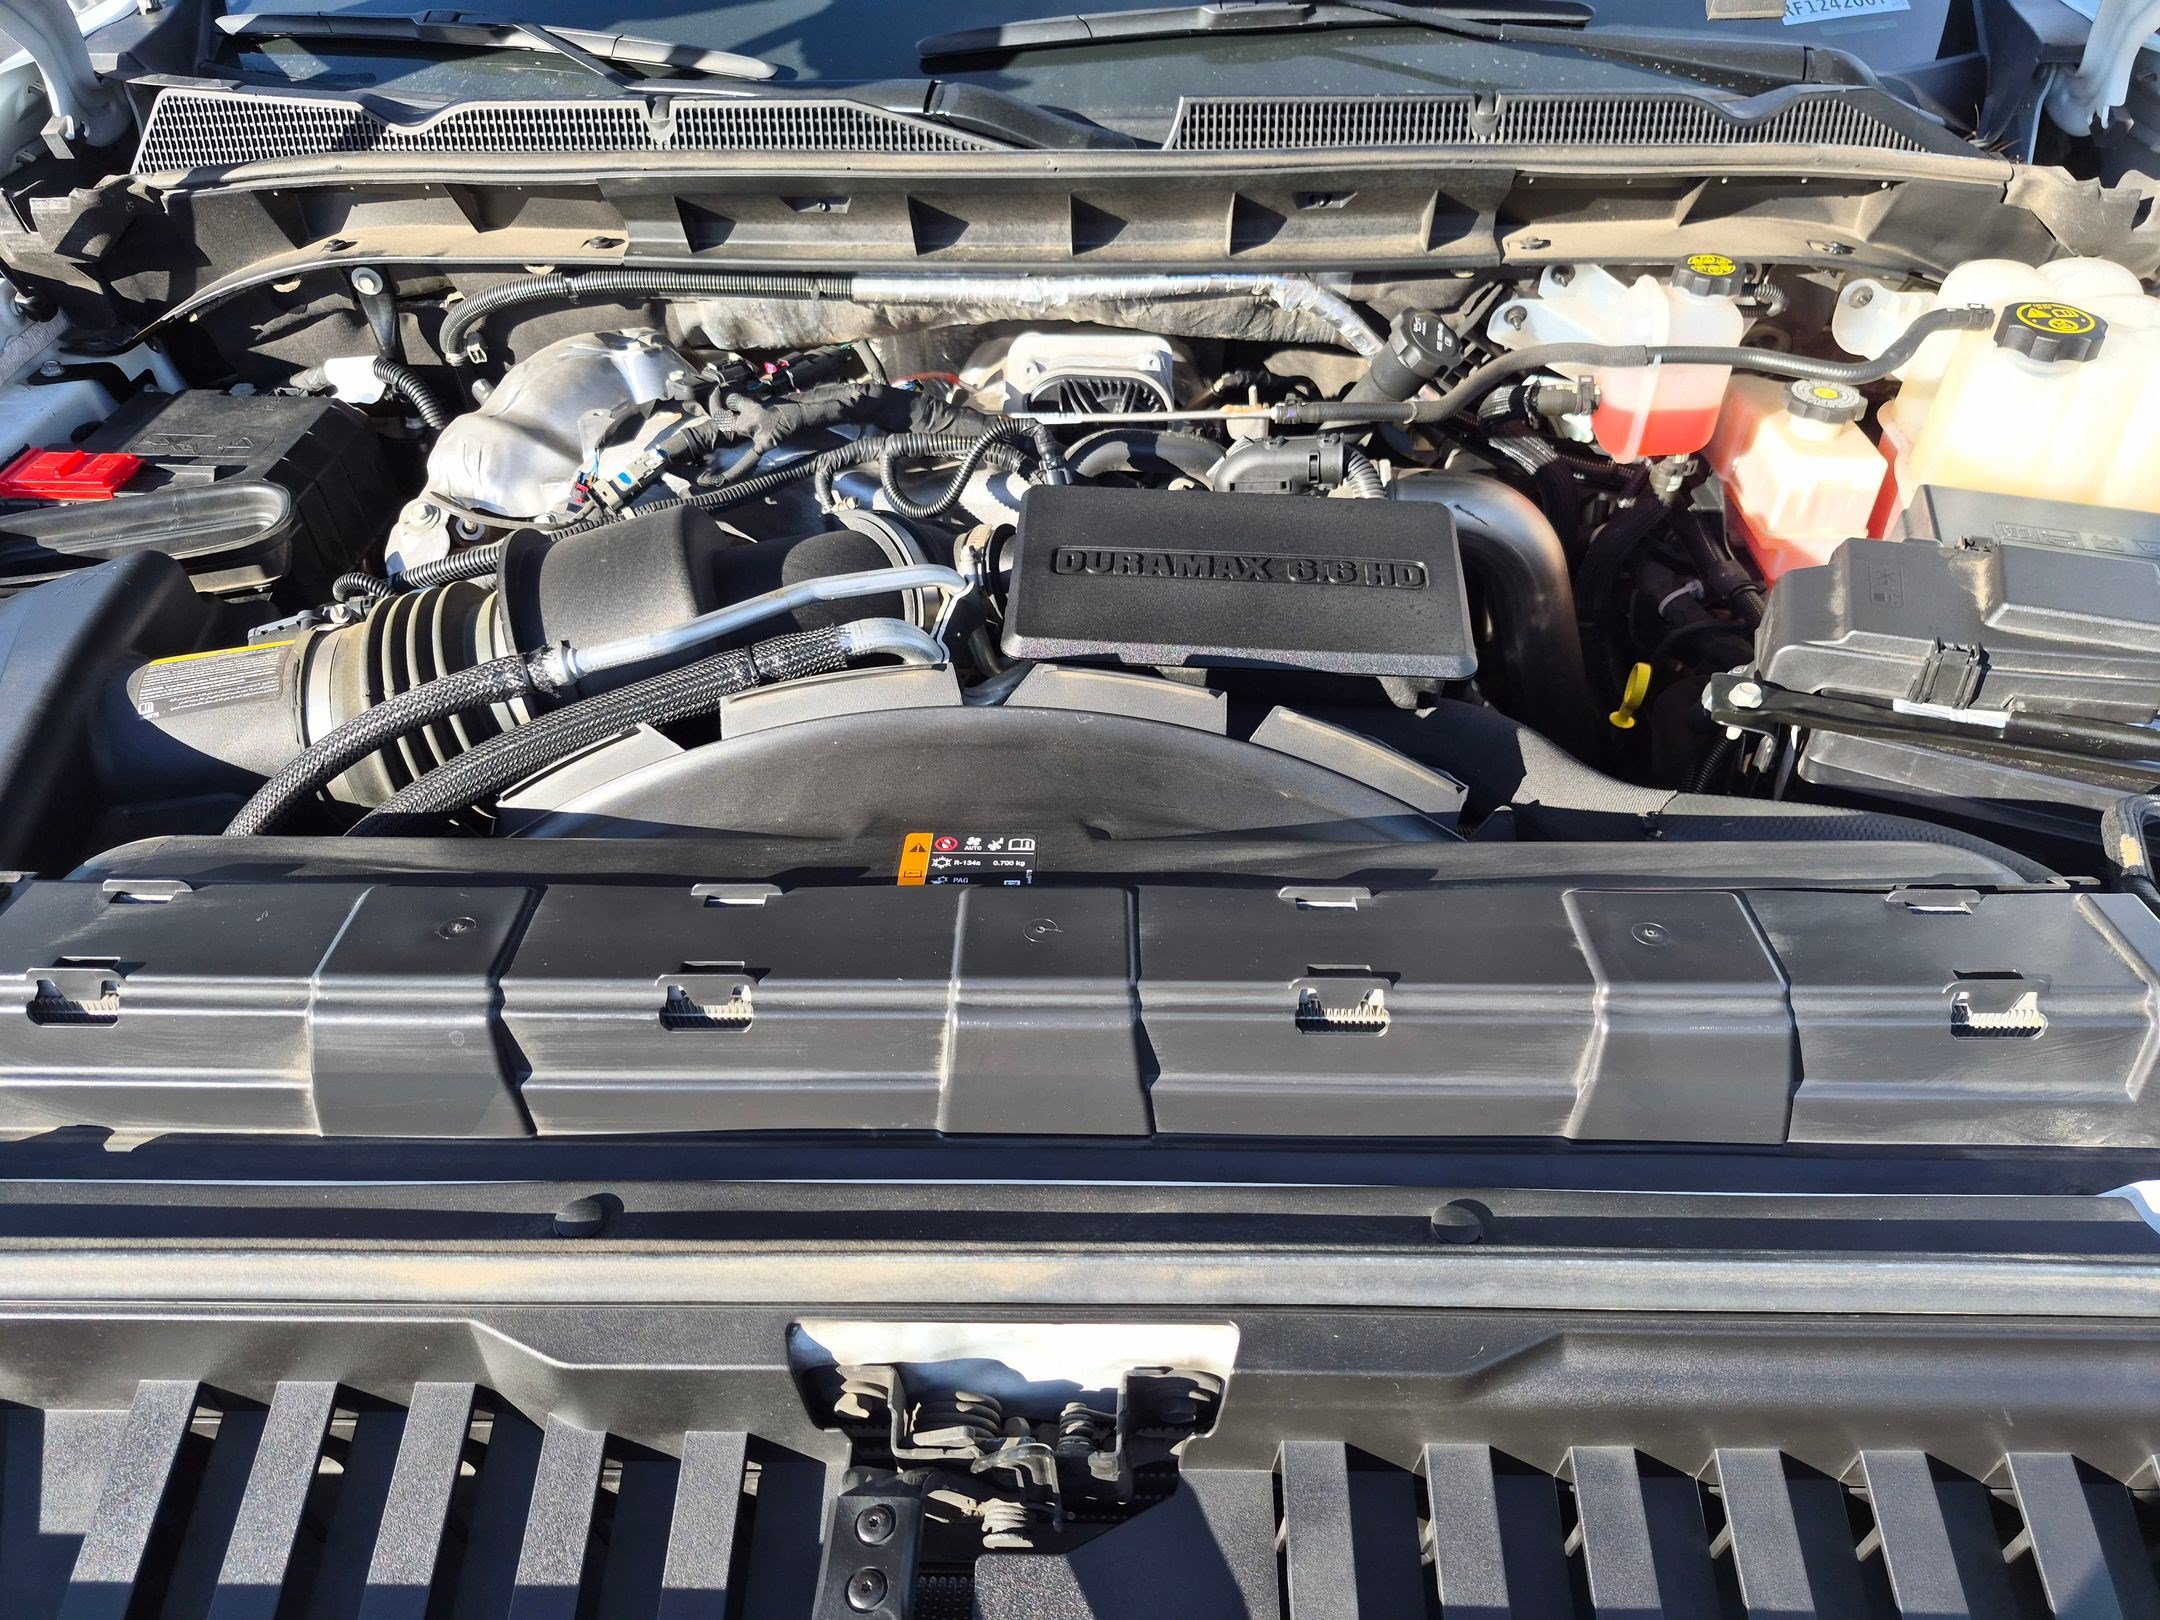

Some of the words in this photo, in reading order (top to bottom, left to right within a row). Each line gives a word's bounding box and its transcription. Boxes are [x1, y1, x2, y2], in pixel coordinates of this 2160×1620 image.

[1061, 549, 1273, 581] DURAMAX
[1286, 559, 1358, 584] 6.6
[1364, 560, 1427, 589] HD
